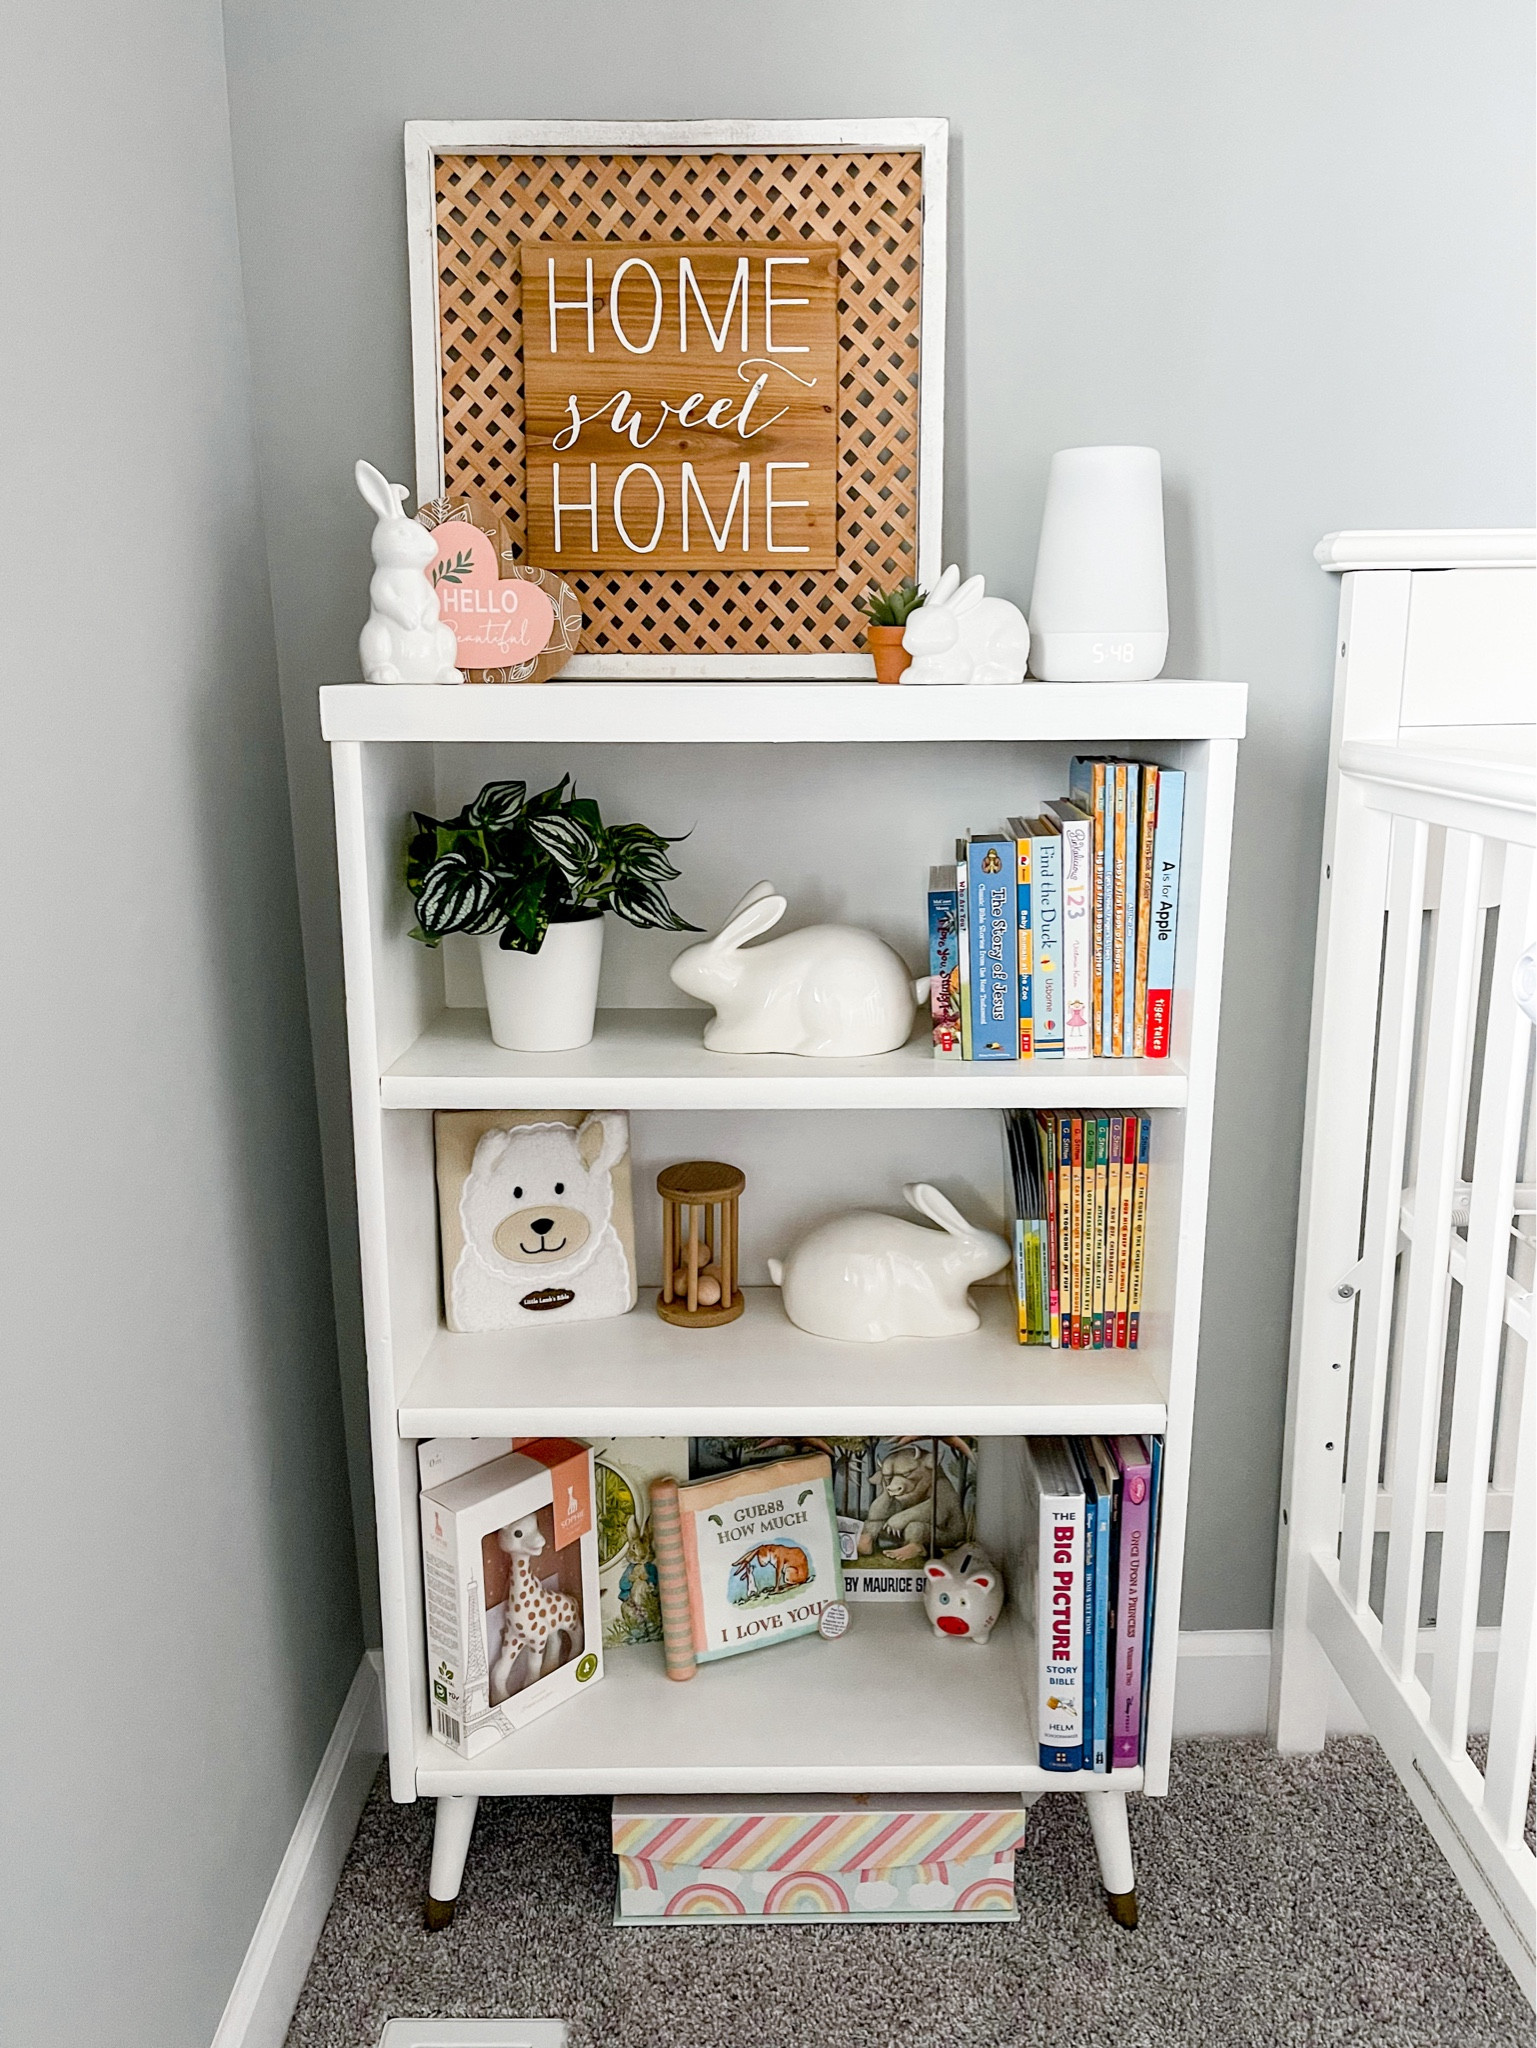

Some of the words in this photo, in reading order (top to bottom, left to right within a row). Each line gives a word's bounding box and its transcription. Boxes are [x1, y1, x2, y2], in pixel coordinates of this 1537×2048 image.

[548, 257, 810, 354] HOME
[552, 358, 818, 451] sweet
[552, 461, 810, 553] HOME
[442, 588, 518, 614] HELLO
[1039, 845, 1055, 878] Find
[1067, 828, 1086, 881] Pinkalicious
[1095, 851, 1104, 865] Big
[1144, 856, 1152, 872] Book
[1095, 866, 1104, 890] Bird's
[1115, 858, 1124, 887] Abby's
[1144, 872, 1151, 880] of
[1161, 861, 1176, 872] A
[1162, 873, 1172, 882] is
[958, 880, 966, 898] Who
[978, 883, 988, 906] Classic
[1040, 881, 1056, 906] the
[1161, 885, 1172, 898] for
[958, 899, 967, 913] Are
[990, 887, 1007, 916] The
[958, 913, 967, 932] You?
[978, 907, 987, 924] Bible
[1019, 909, 1029, 930] Baby
[1095, 913, 1103, 935] Book
[1114, 909, 1123, 931] Book
[1154, 900, 1173, 941] Apple
[978, 924, 987, 950] Stories
[988, 919, 1007, 961] Story
[1040, 908, 1057, 950] Duck
[1095, 935, 1103, 945] of
[1114, 931, 1122, 941] of
[1021, 931, 1029, 961] Animals
[978, 950, 987, 967] from
[1021, 962, 1029, 973] at
[1113, 943, 1122, 973] Shapes
[991, 962, 1009, 980] of
[1021, 973, 1029, 985] the
[990, 982, 1007, 1021] Jesus
[1021, 985, 1030, 1001] Zoo
[1045, 977, 1055, 1013] Usborne
[1153, 998, 1166, 1024] tiger
[1152, 1026, 1164, 1051] tales
[1062, 1137, 1070, 1160] Stilton
[1073, 1138, 1081, 1161] Stilton
[1098, 1136, 1106, 1159] Stilton
[1112, 1134, 1120, 1157] Stilton
[1085, 1207, 1093, 1240] TREASURE
[1096, 1228, 1102, 1237] OF
[1136, 1224, 1142, 1233] OF
[1073, 1241, 1080, 1249] IN
[1085, 1242, 1092, 1251] OF
[1121, 1249, 1127, 1257] IN
[1063, 1253, 1069, 1262] OF
[1063, 1264, 1069, 1275] MY
[1084, 1267, 1092, 1297] EMERALD
[1132, 1274, 1140, 1305] PYRAMID
[733, 1499, 785, 1522] GUESS
[1052, 1512, 1076, 1521] THE
[717, 1522, 755, 1545] HOW
[760, 1510, 808, 1533] MUCH
[1053, 1526, 1075, 1564] BIG
[1130, 1530, 1142, 1558] ONCE
[844, 1576, 860, 1593] BY
[863, 1577, 913, 1593] MAURICE
[1085, 1573, 1093, 1593] HOME
[1129, 1560, 1140, 1587] UPON
[1052, 1571, 1074, 1661] PICTURE
[1085, 1594, 1093, 1615] SWEET
[721, 1628, 729, 1643] I
[736, 1614, 783, 1639] LOVE
[1084, 1616, 1092, 1635] HOME
[1127, 1596, 1138, 1638] PRINCESS
[1046, 1665, 1078, 1674] STORY
[1049, 1677, 1075, 1686] BIBLE
[1048, 1723, 1074, 1732] HELM
